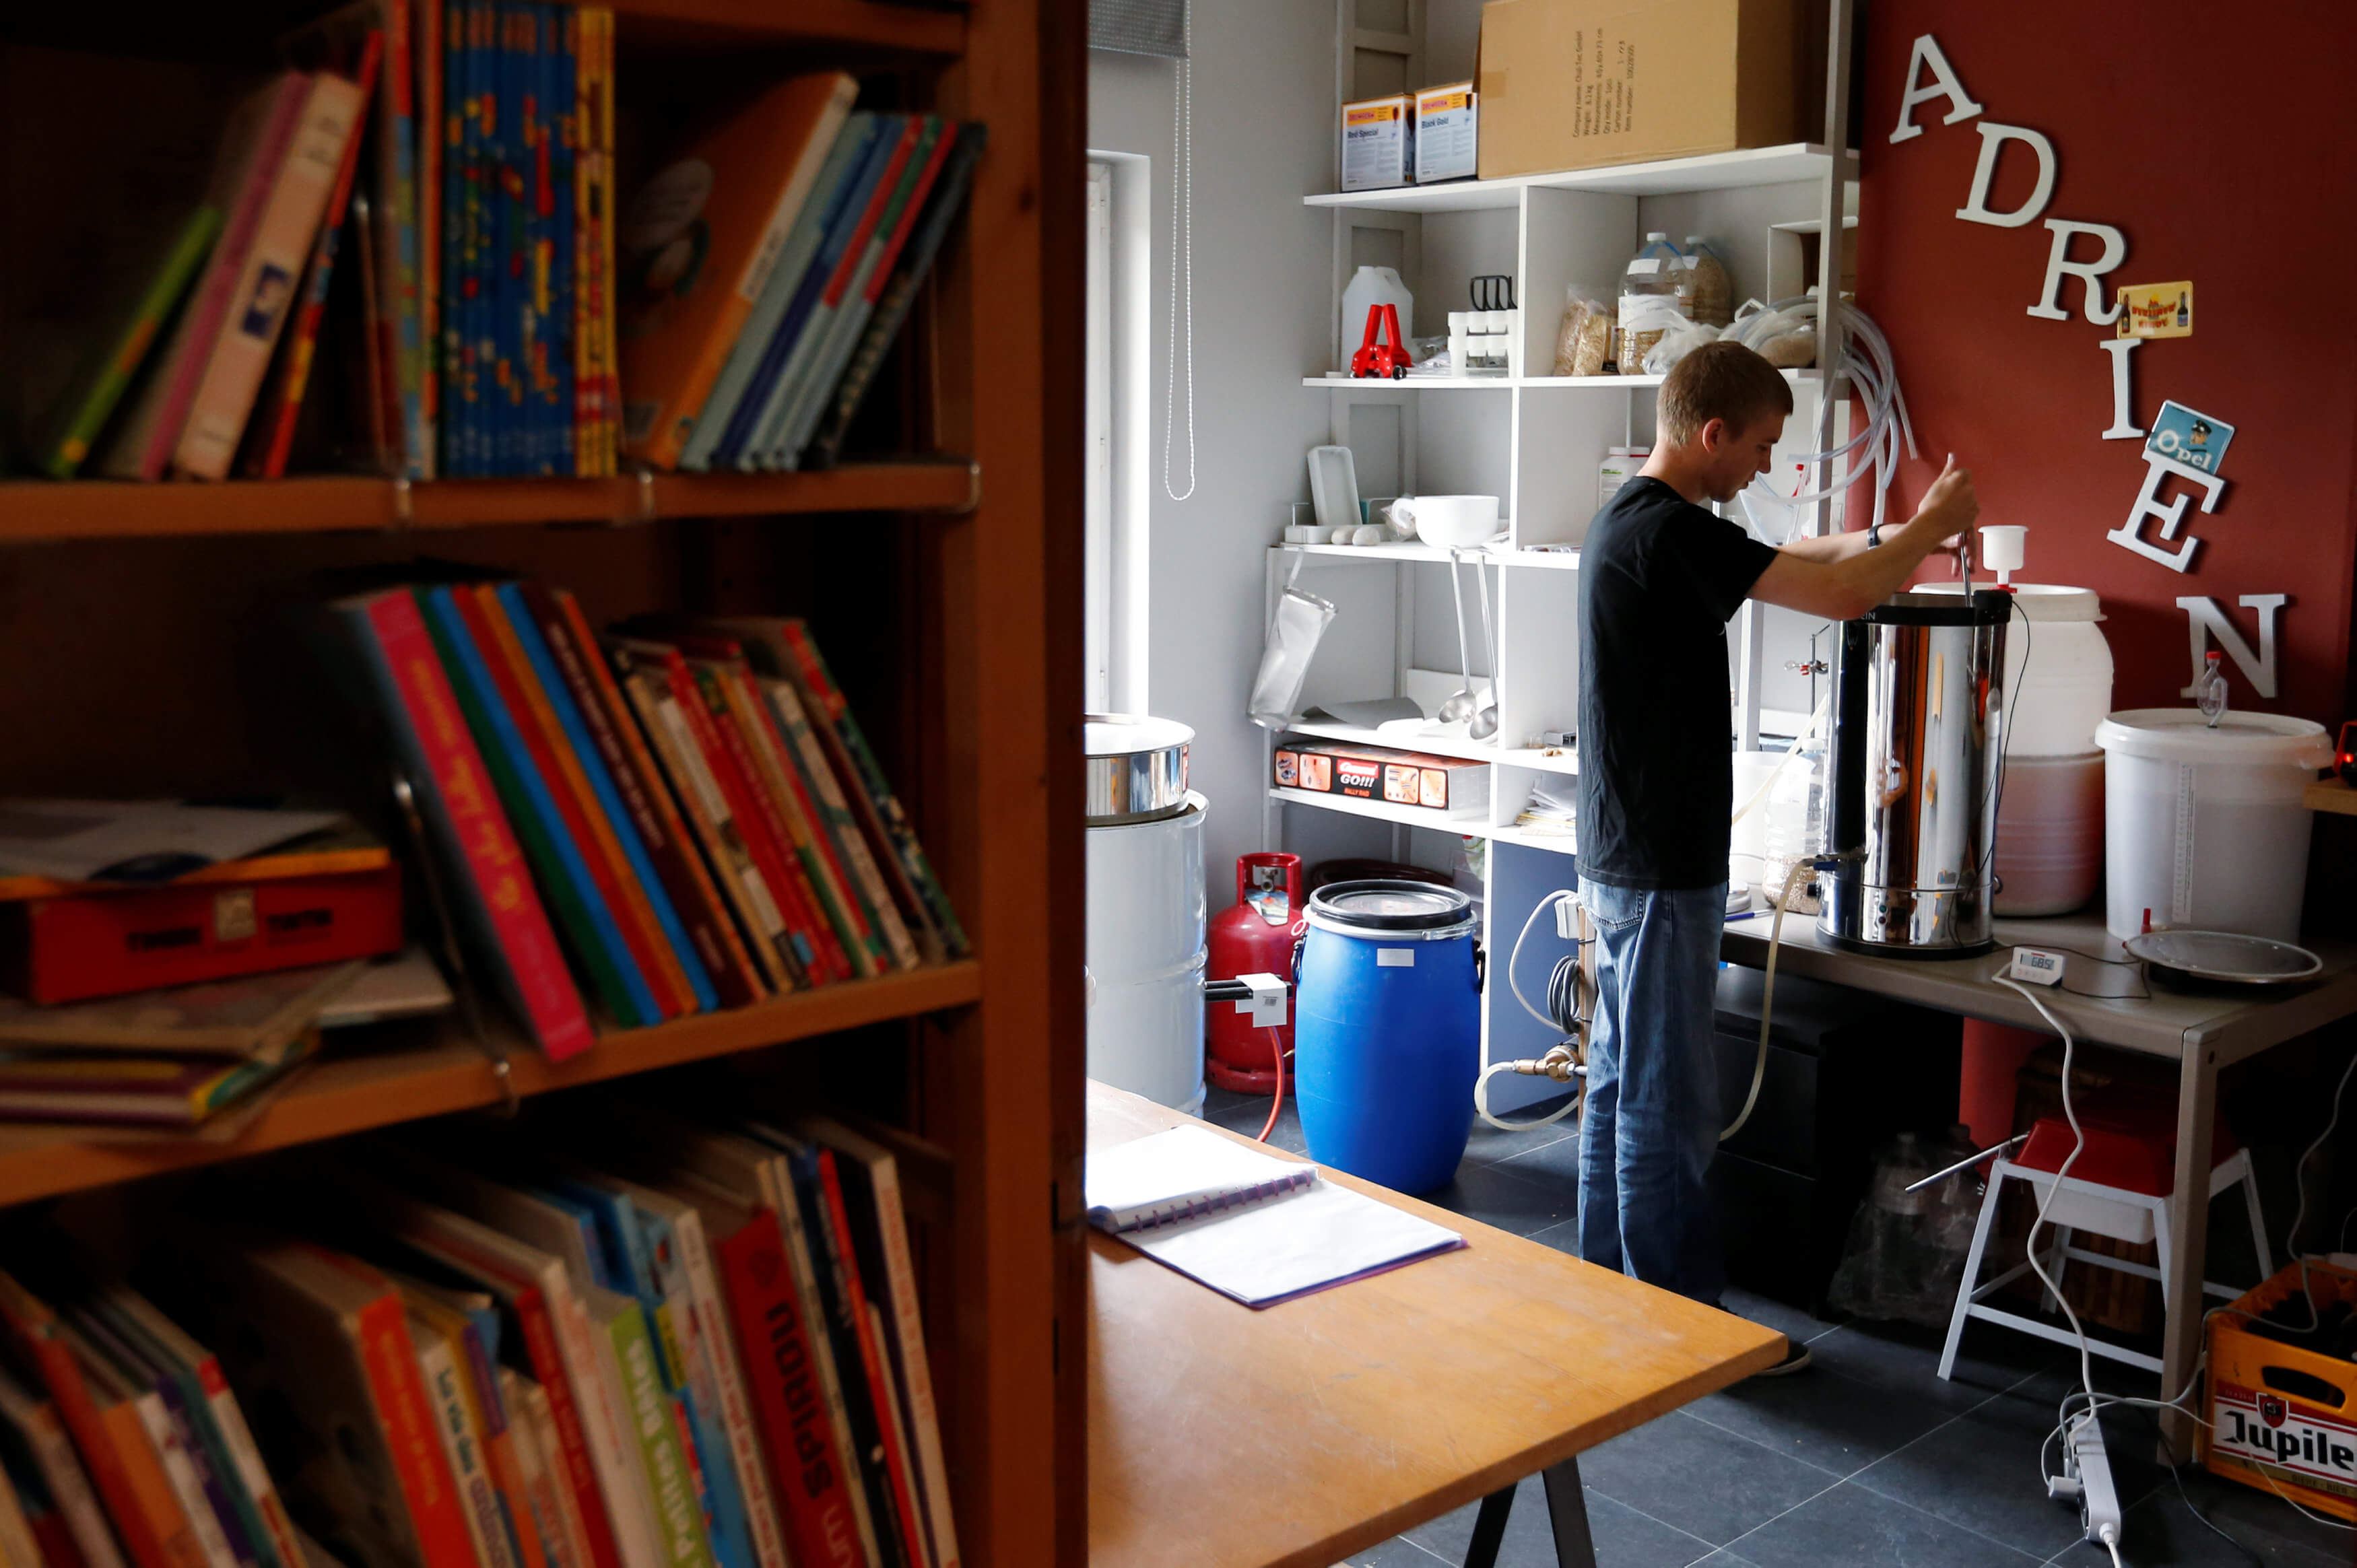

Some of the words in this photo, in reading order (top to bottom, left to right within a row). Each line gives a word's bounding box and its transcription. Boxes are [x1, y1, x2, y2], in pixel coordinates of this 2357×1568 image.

[1348, 130, 1358, 138] Red
[1359, 129, 1379, 141] Special
[1422, 118, 1435, 129] Black
[1436, 117, 1449, 125] Gold
[1573, 106, 1583, 137] Company
[2156, 429, 2212, 470] Opel
[1340, 774, 1374, 788] GO!!!
[767, 1301, 833, 1499] SPIROU
[2222, 1410, 2355, 1472] Jupile
